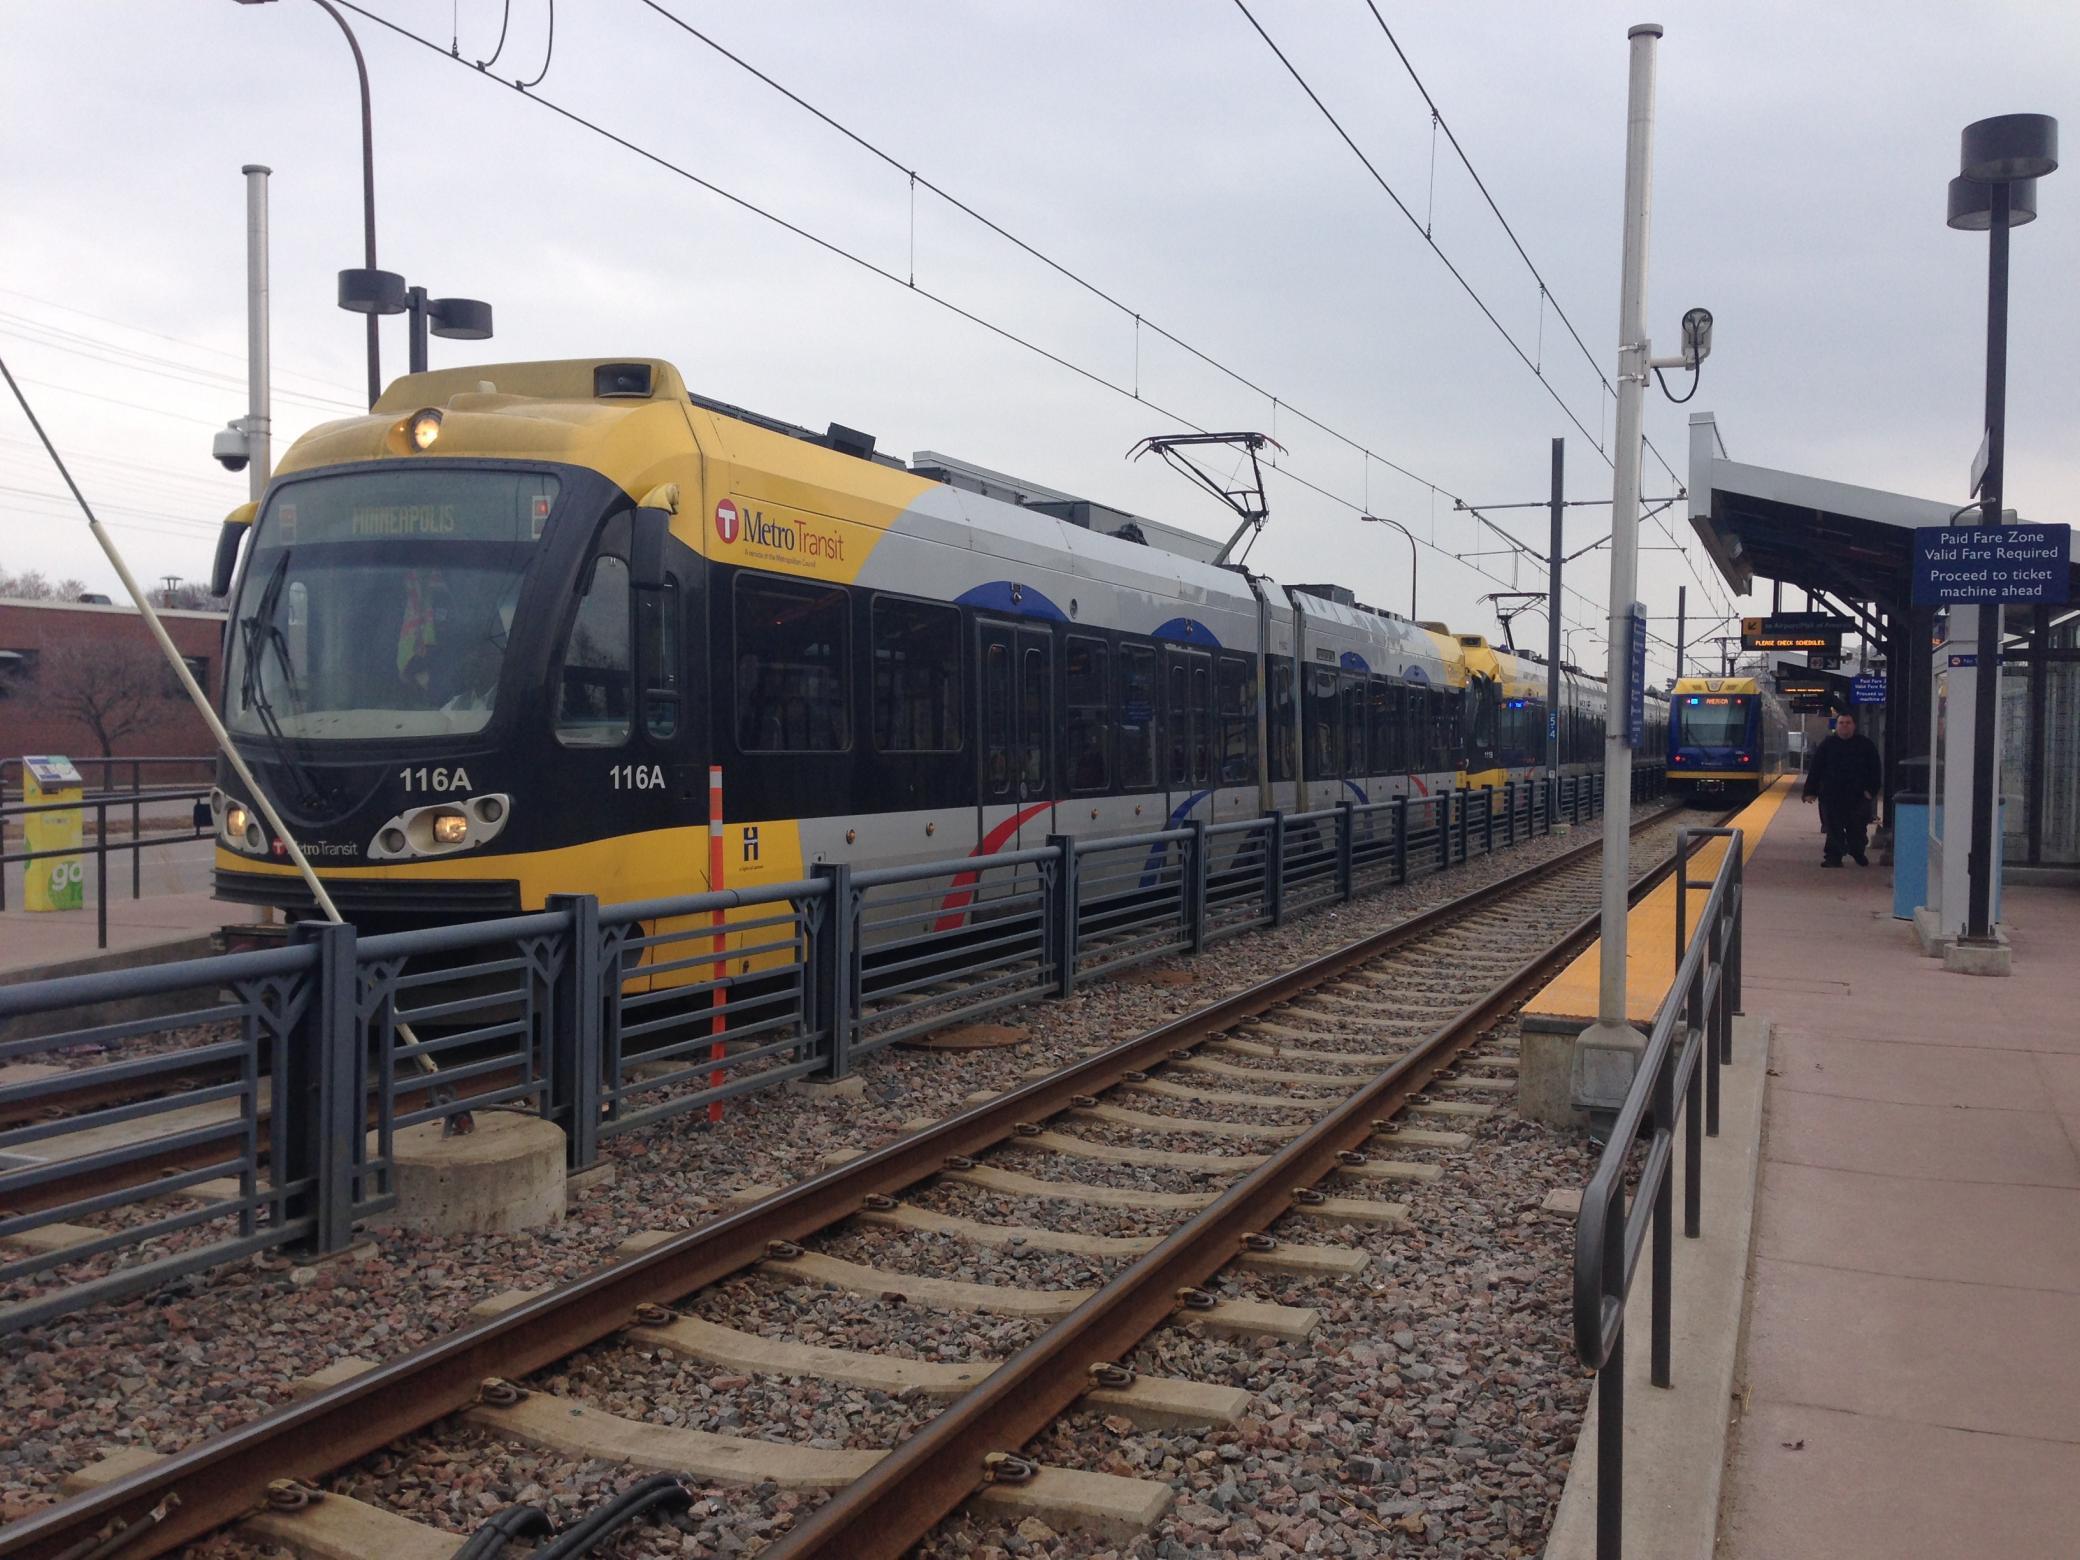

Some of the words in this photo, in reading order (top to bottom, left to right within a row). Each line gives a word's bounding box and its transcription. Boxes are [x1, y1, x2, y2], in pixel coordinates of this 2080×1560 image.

[717, 506, 737, 540] T
[1940, 533, 1968, 544] Paid
[1974, 532, 2003, 543] Fare
[2008, 531, 2045, 543] Zone
[1925, 549, 1957, 560] Valid
[1962, 549, 1991, 559] Fare
[1996, 546, 2058, 561] Required
[1930, 569, 1987, 581] Proceed
[1993, 571, 2007, 580] to
[2013, 568, 2052, 580] ticket
[1940, 585, 1997, 597] machine
[2001, 584, 2042, 596] ahead
[400, 767, 473, 792] 116A
[609, 765, 666, 790] 116A
[52, 862, 83, 892] go
